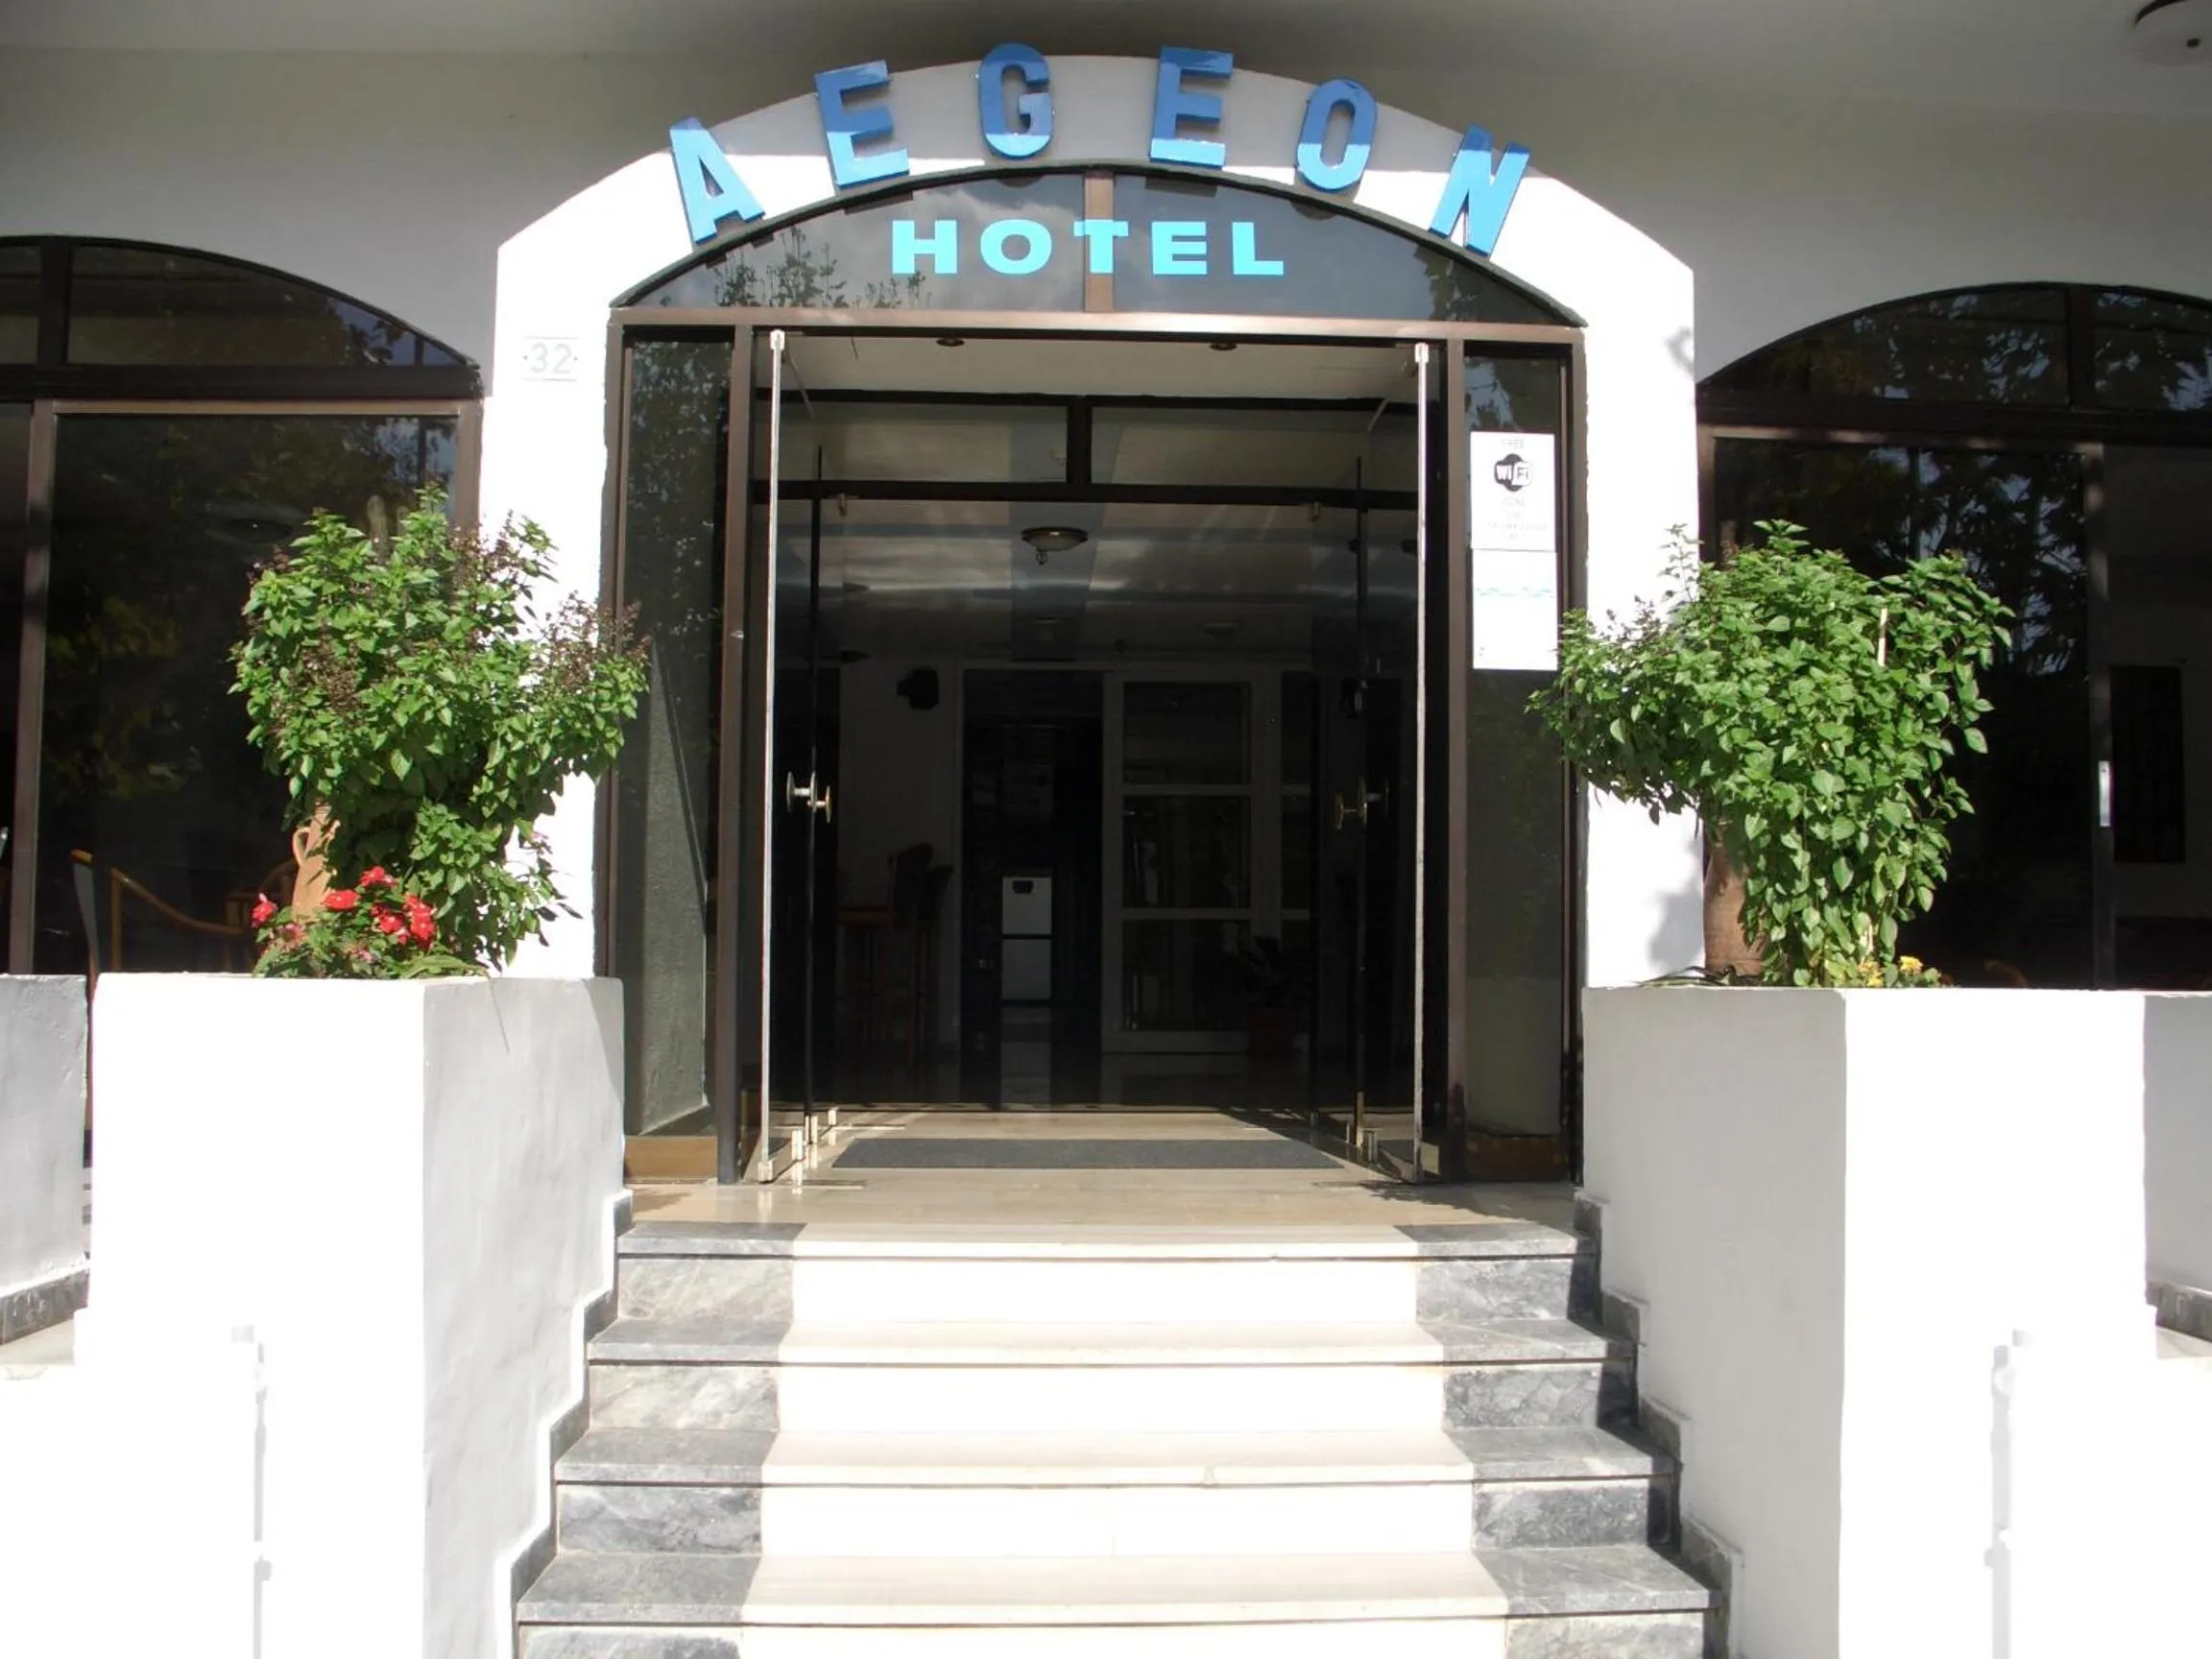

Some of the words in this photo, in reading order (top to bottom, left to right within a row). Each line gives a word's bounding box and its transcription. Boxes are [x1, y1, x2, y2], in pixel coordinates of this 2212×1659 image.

[669, 42, 1531, 257] AEGEON
[891, 219, 1285, 276] HOTEL
[530, 342, 572, 373] 32
